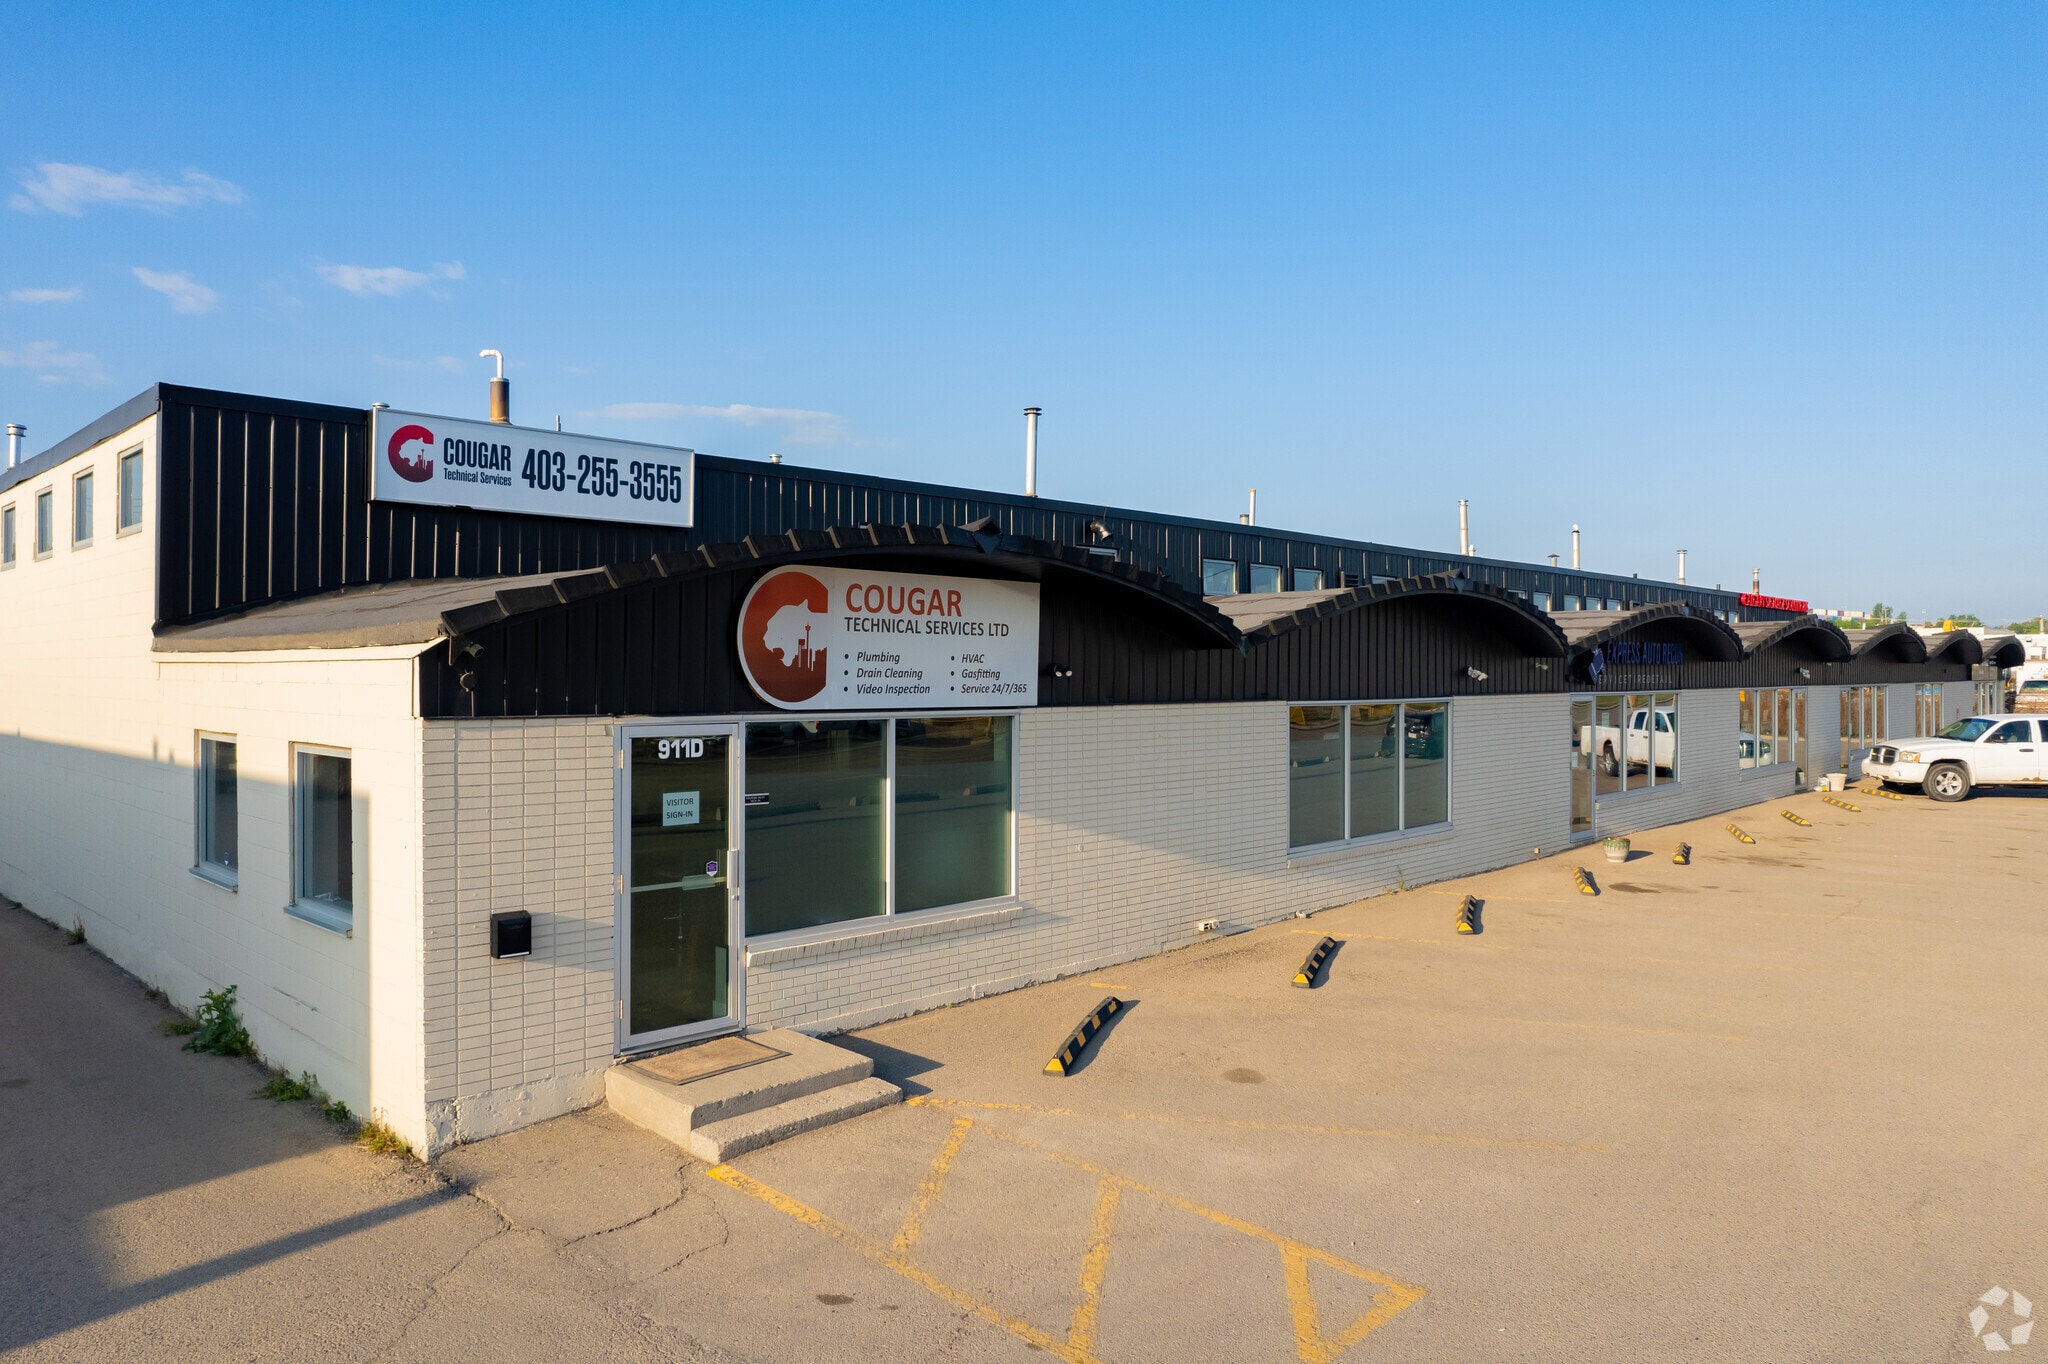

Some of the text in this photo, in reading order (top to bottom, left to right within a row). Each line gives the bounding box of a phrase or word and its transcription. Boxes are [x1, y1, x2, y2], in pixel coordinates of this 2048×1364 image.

[443, 437, 512, 472] COUGAR
[444, 468, 512, 487] Technical Services
[521, 448, 682, 504] 403-255-3555
[845, 583, 963, 617] COUGAR
[844, 616, 1009, 637] TECHNICAL SERVICES LTD
[857, 651, 900, 664] Plumbing
[1606, 639, 1640, 665] EXPRESS
[1643, 641, 1660, 665] AUTO
[961, 653, 985, 664] HVAC
[857, 668, 923, 680] Drain Cleaning
[961, 668, 1001, 680] Gasfitting
[1598, 674, 1627, 684] ERVICE
[857, 684, 930, 696] Video Inspection
[961, 683, 1027, 695] Service 24/7/365
[658, 738, 704, 759] 911D
[666, 798, 694, 807] VISITOR
[666, 810, 693, 819] SIGN-IN
